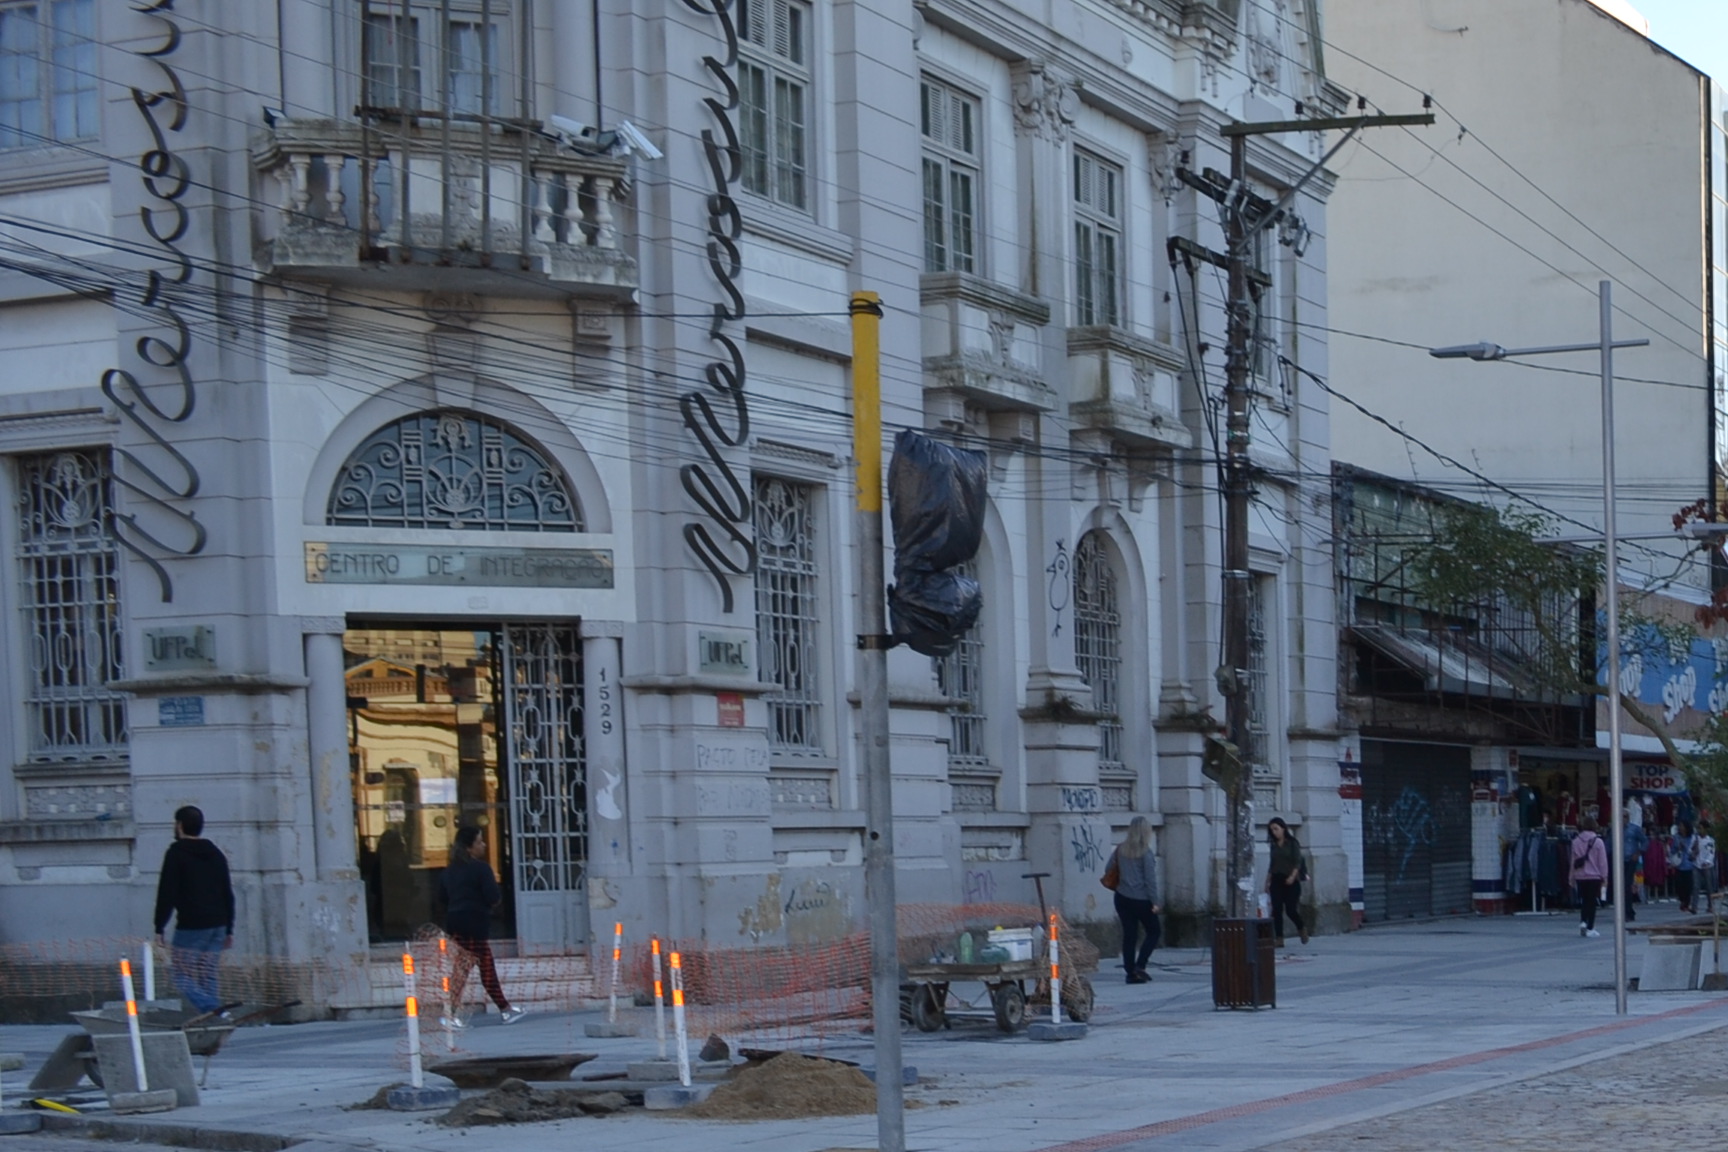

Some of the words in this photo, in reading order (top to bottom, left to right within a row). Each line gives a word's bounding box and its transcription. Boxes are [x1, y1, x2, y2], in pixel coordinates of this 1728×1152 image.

[314, 552, 400, 575] CENTRO
[426, 555, 454, 576] DE
[151, 635, 205, 660] UFPel
[708, 640, 744, 664] UFPel
[598, 667, 613, 735] 1529
[1635, 765, 1670, 777] TOP
[1630, 777, 1675, 790] SHOP
